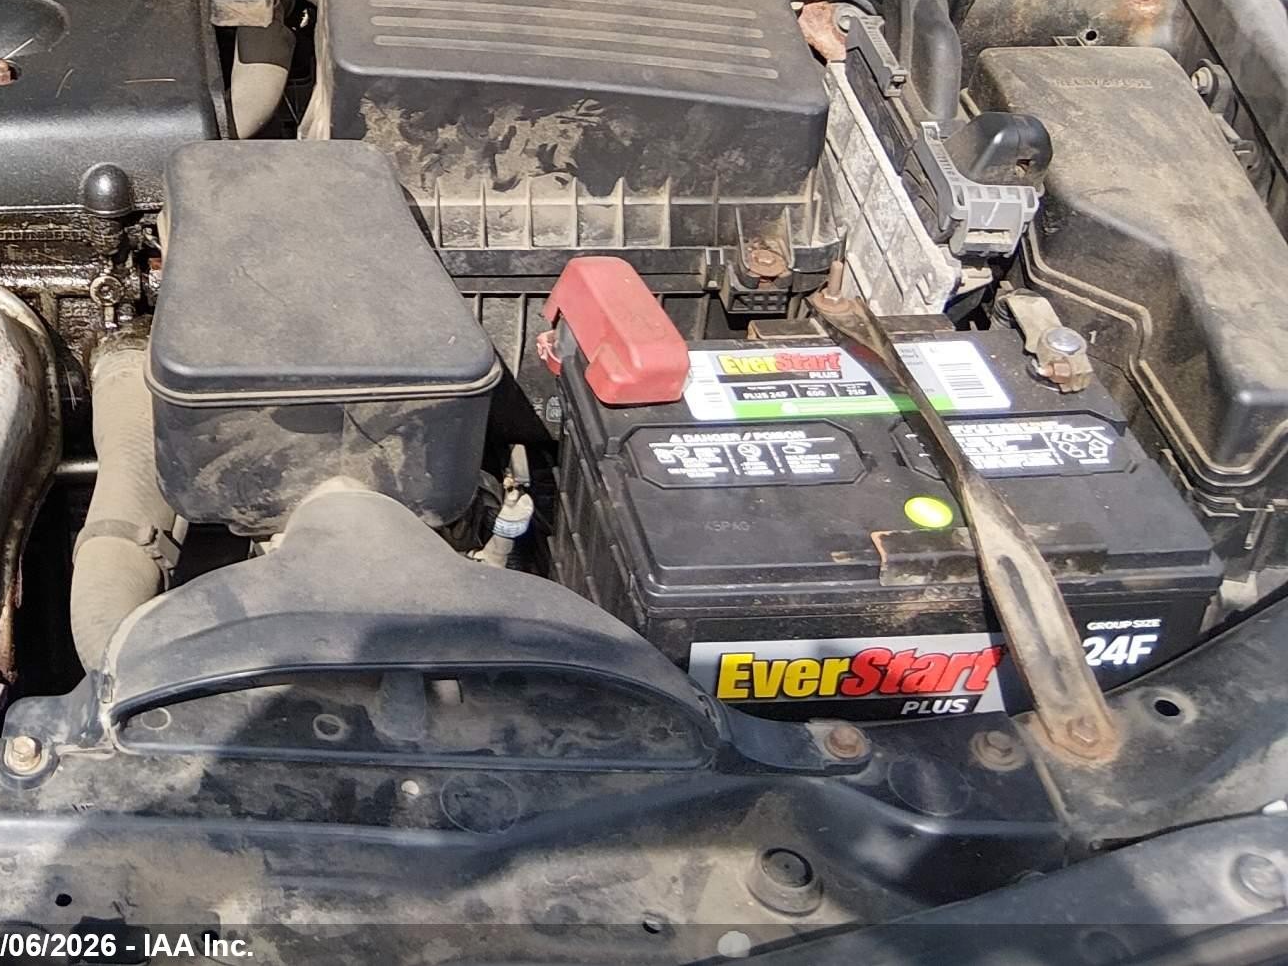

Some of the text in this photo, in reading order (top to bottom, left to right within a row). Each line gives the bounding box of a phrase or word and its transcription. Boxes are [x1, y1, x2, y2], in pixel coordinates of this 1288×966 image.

[717, 352, 841, 374] EverStart
[1087, 618, 1161, 631] GROUP SIZE
[1082, 634, 1158, 666] 24F
[716, 646, 1004, 699] EverStart
[900, 698, 971, 715] PLUS
